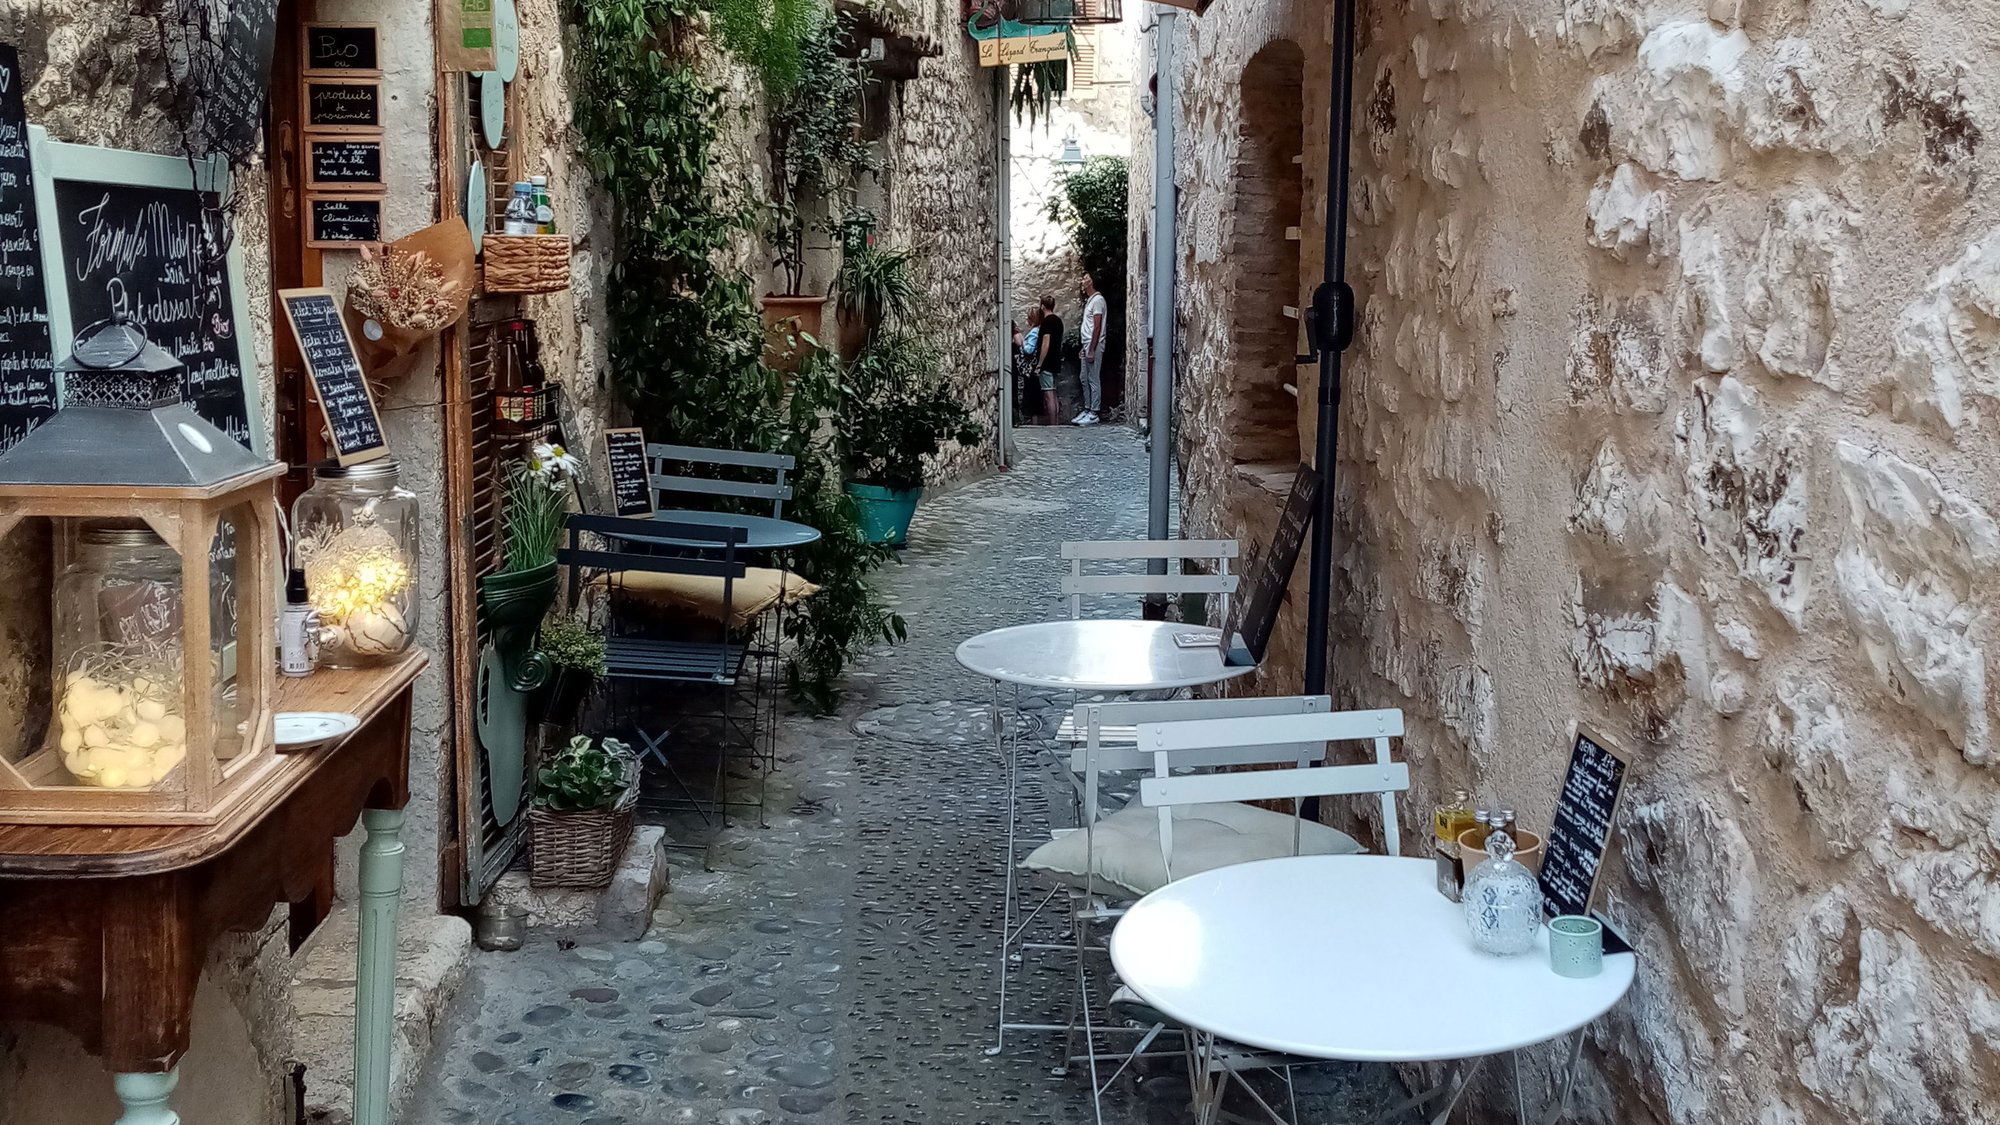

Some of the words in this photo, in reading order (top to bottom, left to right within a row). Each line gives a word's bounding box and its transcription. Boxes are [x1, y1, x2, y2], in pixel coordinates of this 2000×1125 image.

[316, 35, 359, 58] Bio
[981, 44, 993, 58] Le
[1029, 40, 1066, 59] Tranquille
[314, 90, 373, 108] produits
[335, 102, 348, 112] de
[314, 109, 372, 123] proximité
[350, 156, 365, 164] blé
[319, 168, 337, 176] dans
[341, 167, 354, 176] la
[323, 203, 349, 211] Salle
[322, 213, 370, 223] Climatisée
[342, 223, 349, 231] à
[1579, 738, 1597, 757] MENU
